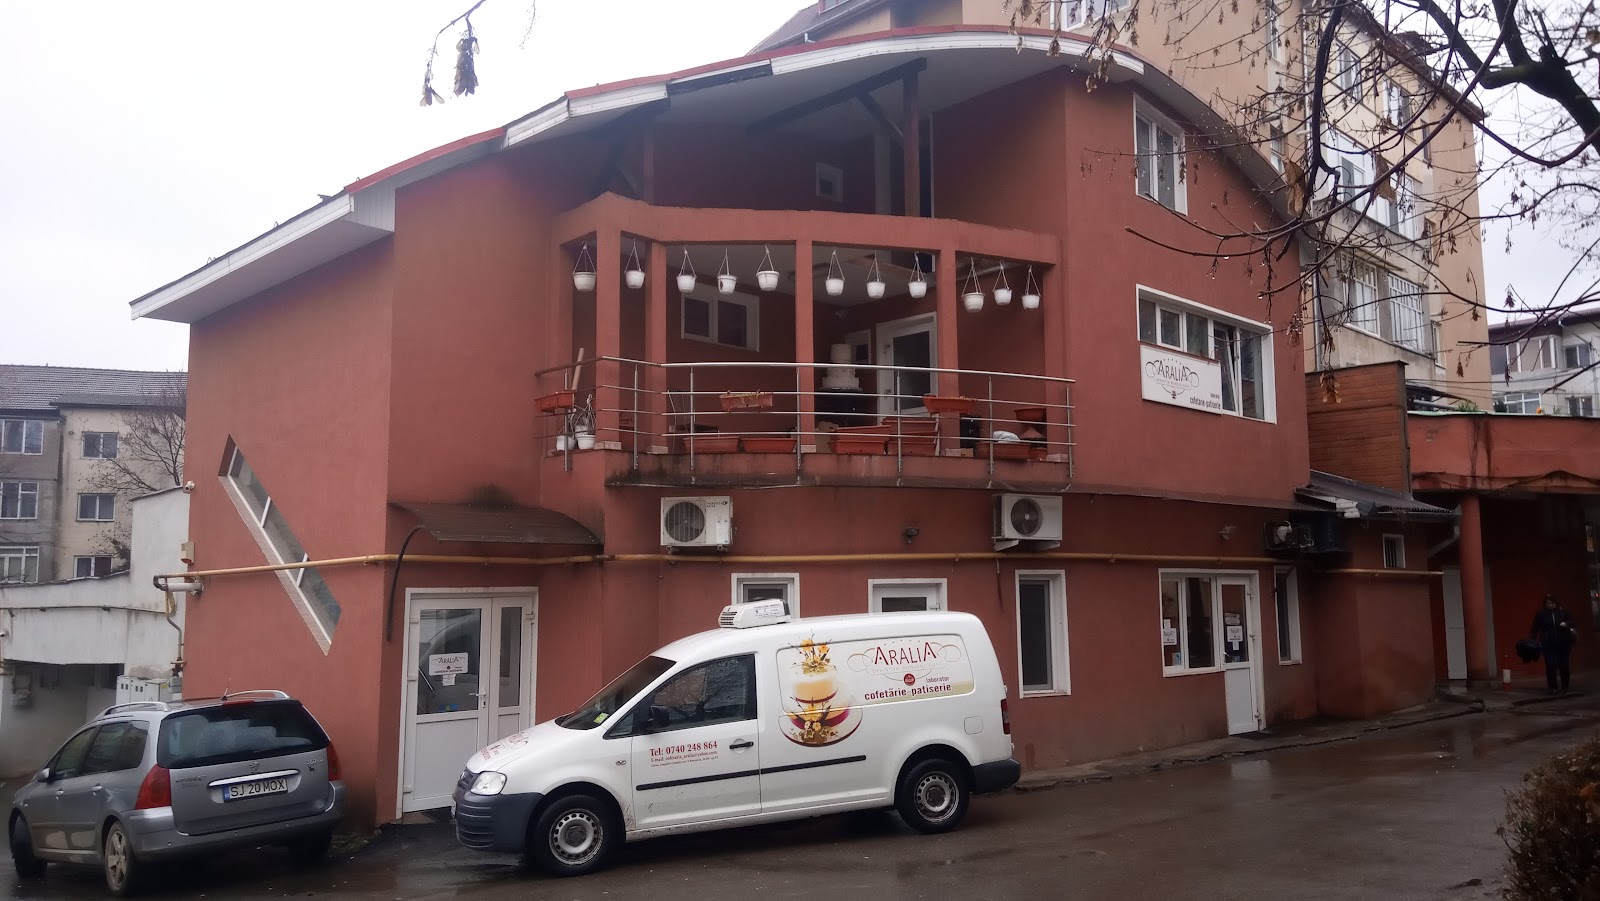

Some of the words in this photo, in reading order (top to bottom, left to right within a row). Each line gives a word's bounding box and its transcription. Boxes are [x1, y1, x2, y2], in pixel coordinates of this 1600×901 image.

[1157, 360, 1188, 381] ARALIA
[874, 642, 937, 665] ARALIA
[649, 747, 664, 757] Tel:
[665, 744, 685, 755] 0740
[687, 742, 702, 752] 248
[703, 740, 718, 750] 864
[230, 785, 245, 797] SJ
[248, 782, 261, 794] 20
[263, 778, 286, 792] MOX
